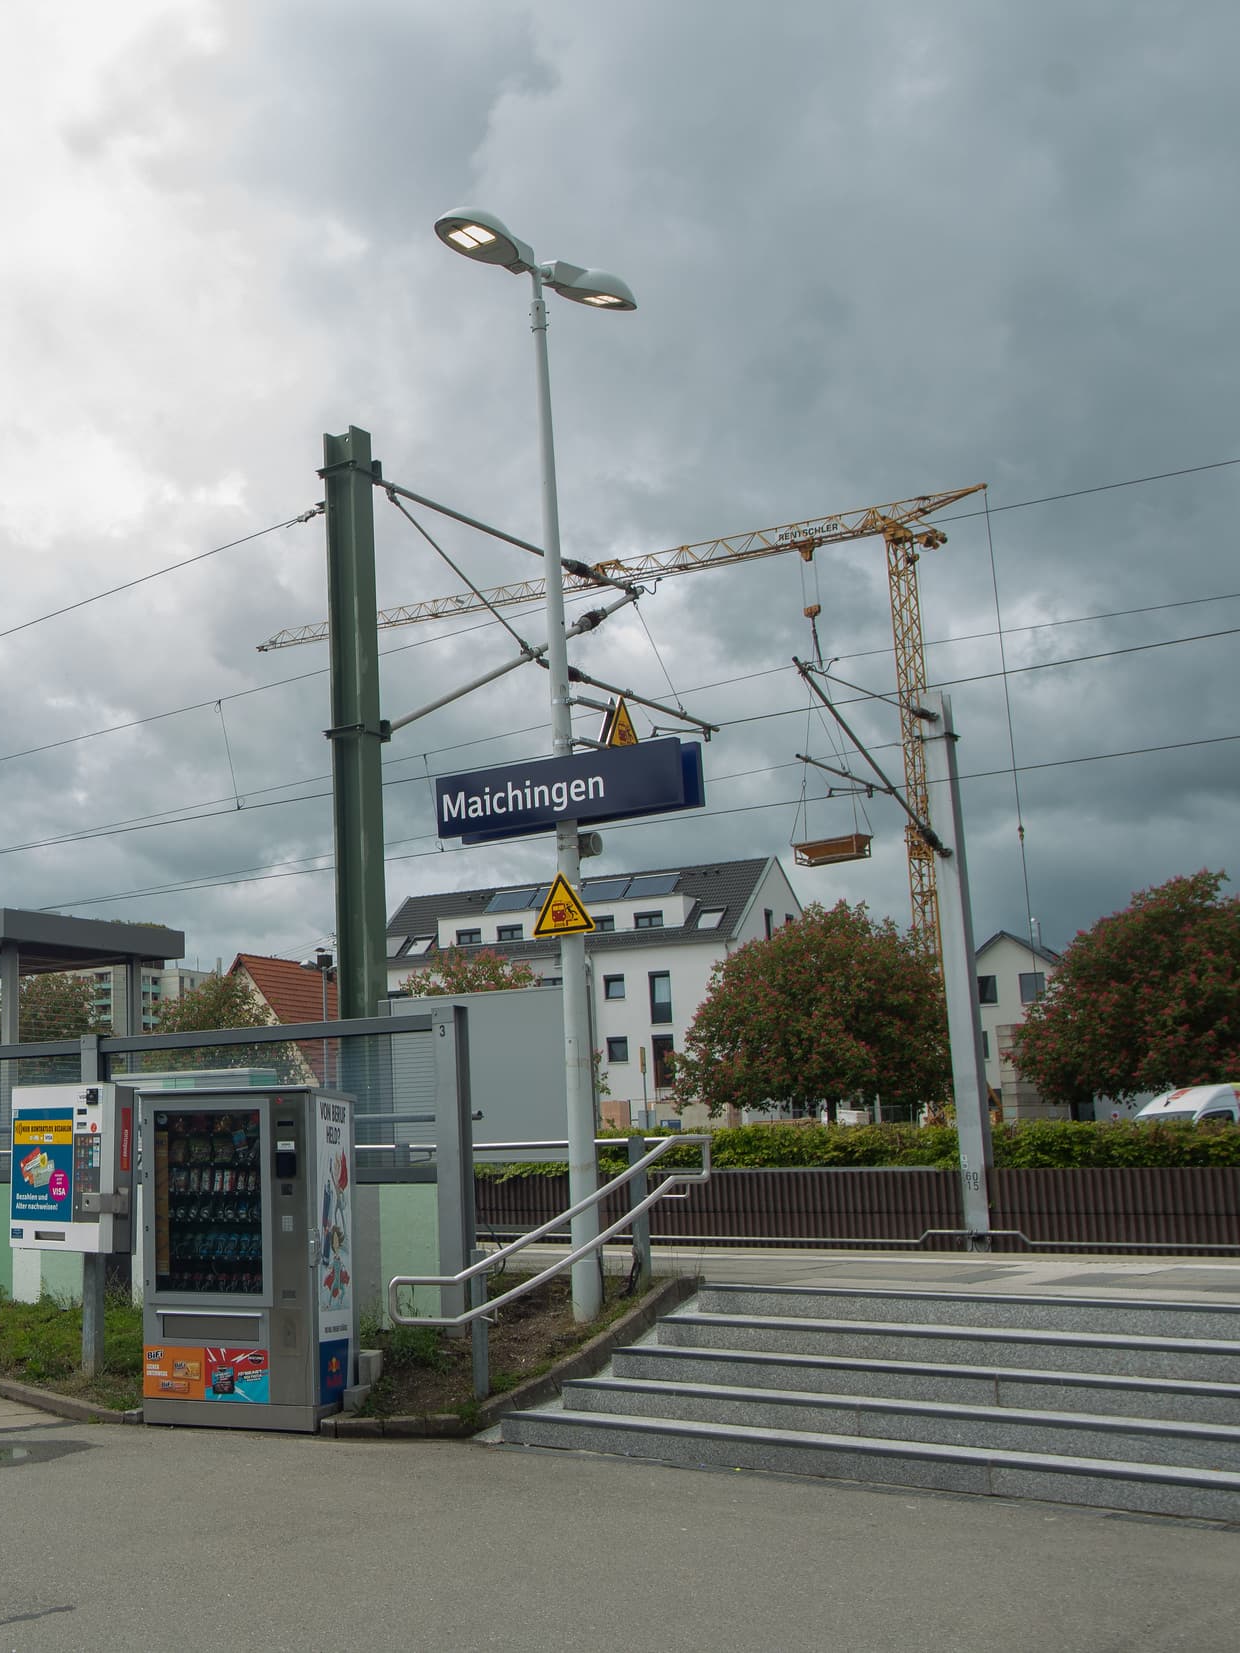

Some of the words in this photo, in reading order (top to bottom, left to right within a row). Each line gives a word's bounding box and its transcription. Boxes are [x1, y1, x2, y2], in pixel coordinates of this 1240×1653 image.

[778, 522, 838, 542] RENTSCHLER
[442, 775, 605, 823] Maichingen
[439, 1025, 446, 1037] 3
[320, 1101, 331, 1121] VON
[331, 1104, 346, 1124] BERUF
[326, 1126, 341, 1144] HELD?
[965, 1171, 978, 1181] 60
[967, 1181, 979, 1191] 15
[16, 1192, 37, 1200] Bezahlen
[52, 1187, 66, 1196] VISA
[28, 1202, 58, 1211] nachweisen!
[147, 1350, 163, 1360] BiFi
